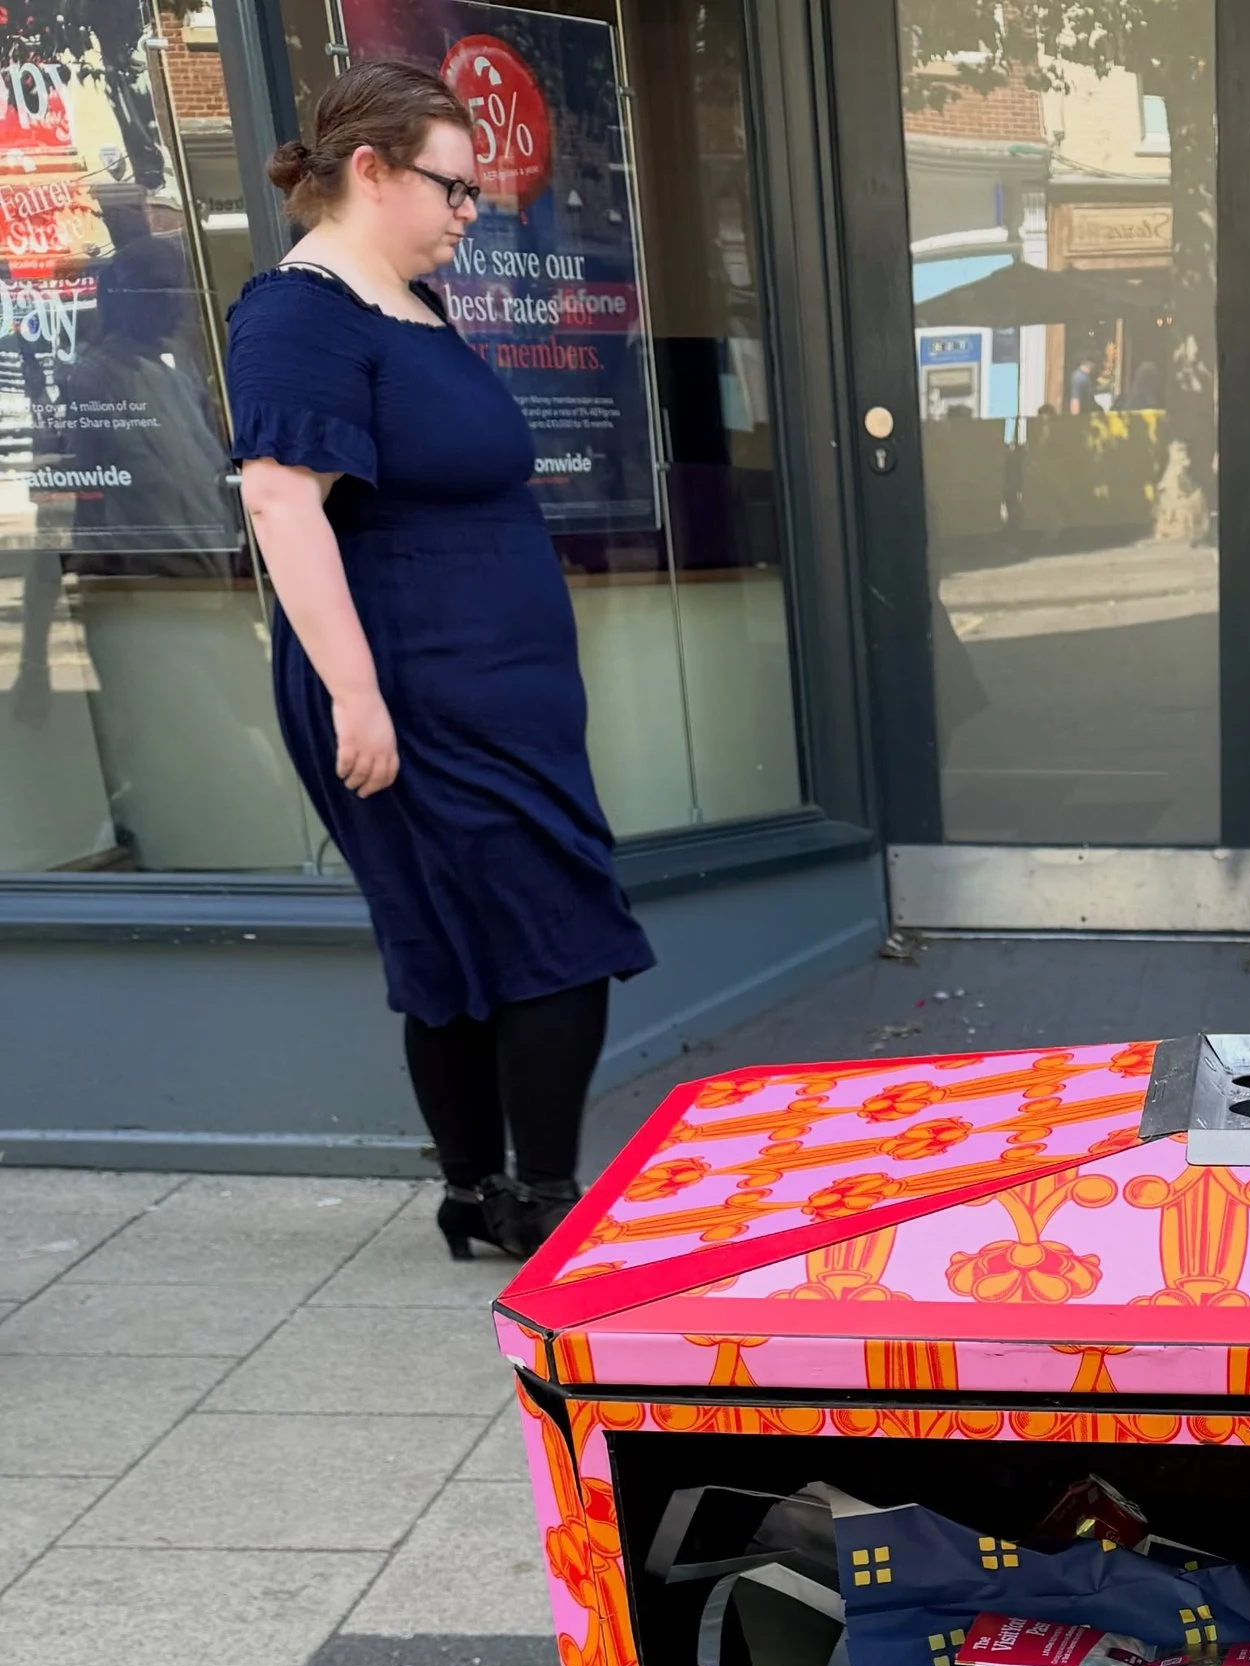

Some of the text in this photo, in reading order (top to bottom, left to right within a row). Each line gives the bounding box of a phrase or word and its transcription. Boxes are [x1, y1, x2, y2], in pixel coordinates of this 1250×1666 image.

[467, 91, 534, 164] 5%
[0, 180, 73, 222] Fairer
[453, 237, 585, 281] We save our
[444, 283, 497, 321] best
[502, 293, 560, 325] rates
[495, 335, 605, 371] members.
[47, 418, 78, 429] Fairer
[79, 418, 111, 429] Share
[112, 417, 161, 430] payment.
[70, 401, 78, 411] 4
[79, 401, 115, 412] million
[116, 400, 128, 411] of
[129, 402, 147, 411] our
[972, 1635, 992, 1650] The
